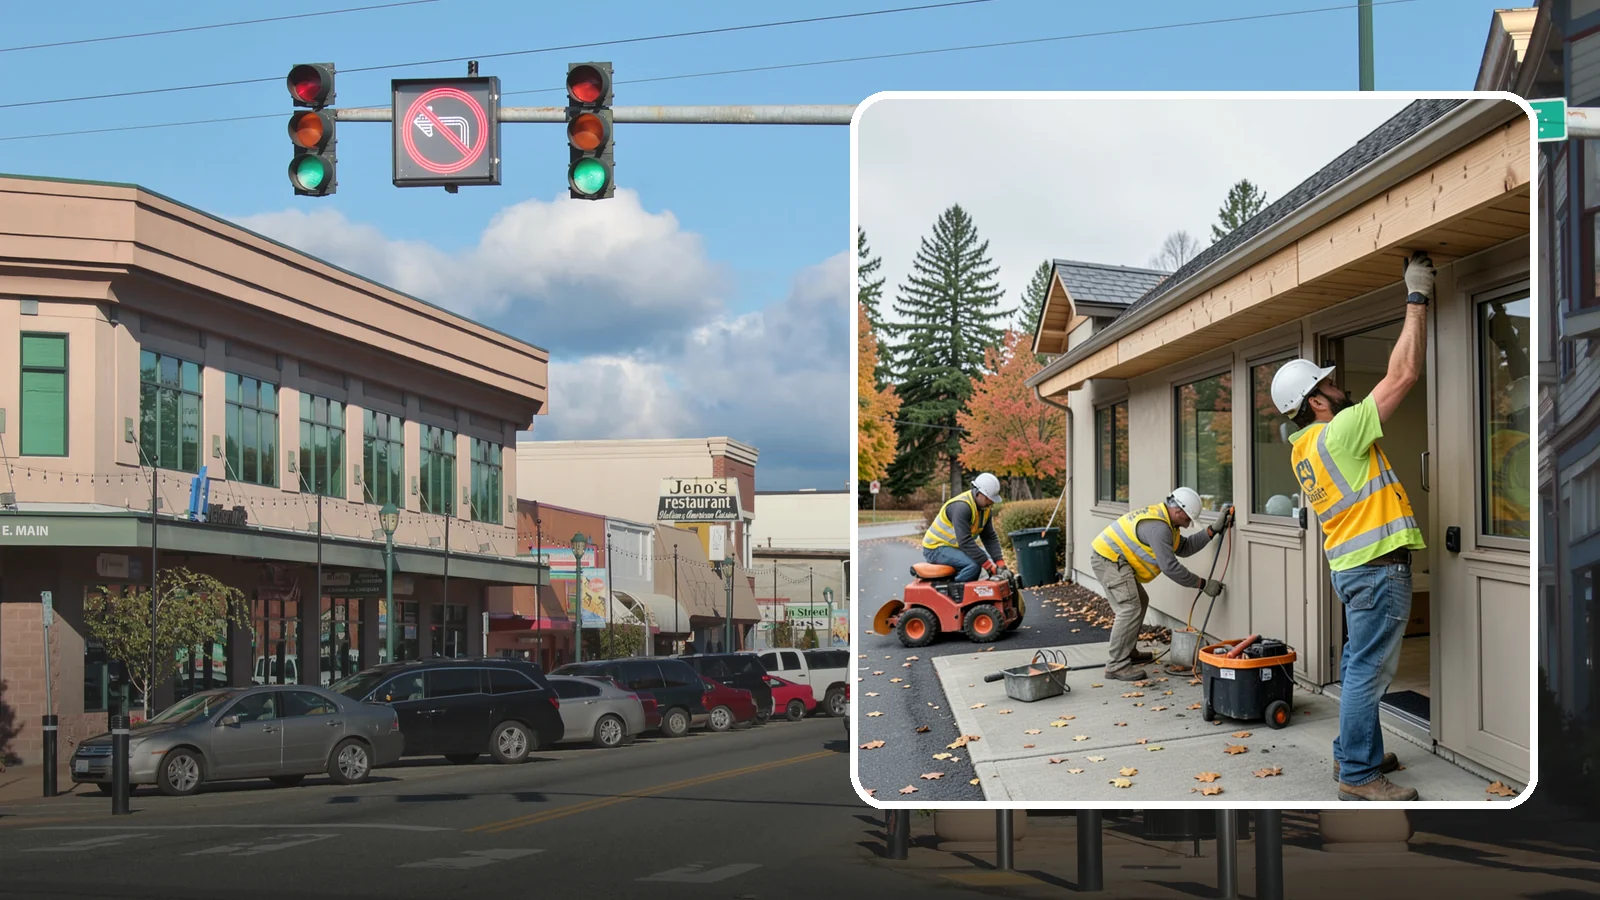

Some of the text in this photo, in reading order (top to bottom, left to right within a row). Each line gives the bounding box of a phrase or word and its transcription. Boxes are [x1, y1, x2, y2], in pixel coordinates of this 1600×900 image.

[669, 480, 727, 494] Jeno's
[665, 496, 731, 509] restaurant
[658, 509, 681, 519] Italian
[686, 509, 715, 519] American
[715, 509, 738, 519] Cuisine
[2, 525, 49, 536] E. MAIN
[797, 607, 829, 617] Street
[790, 619, 824, 627] lass
